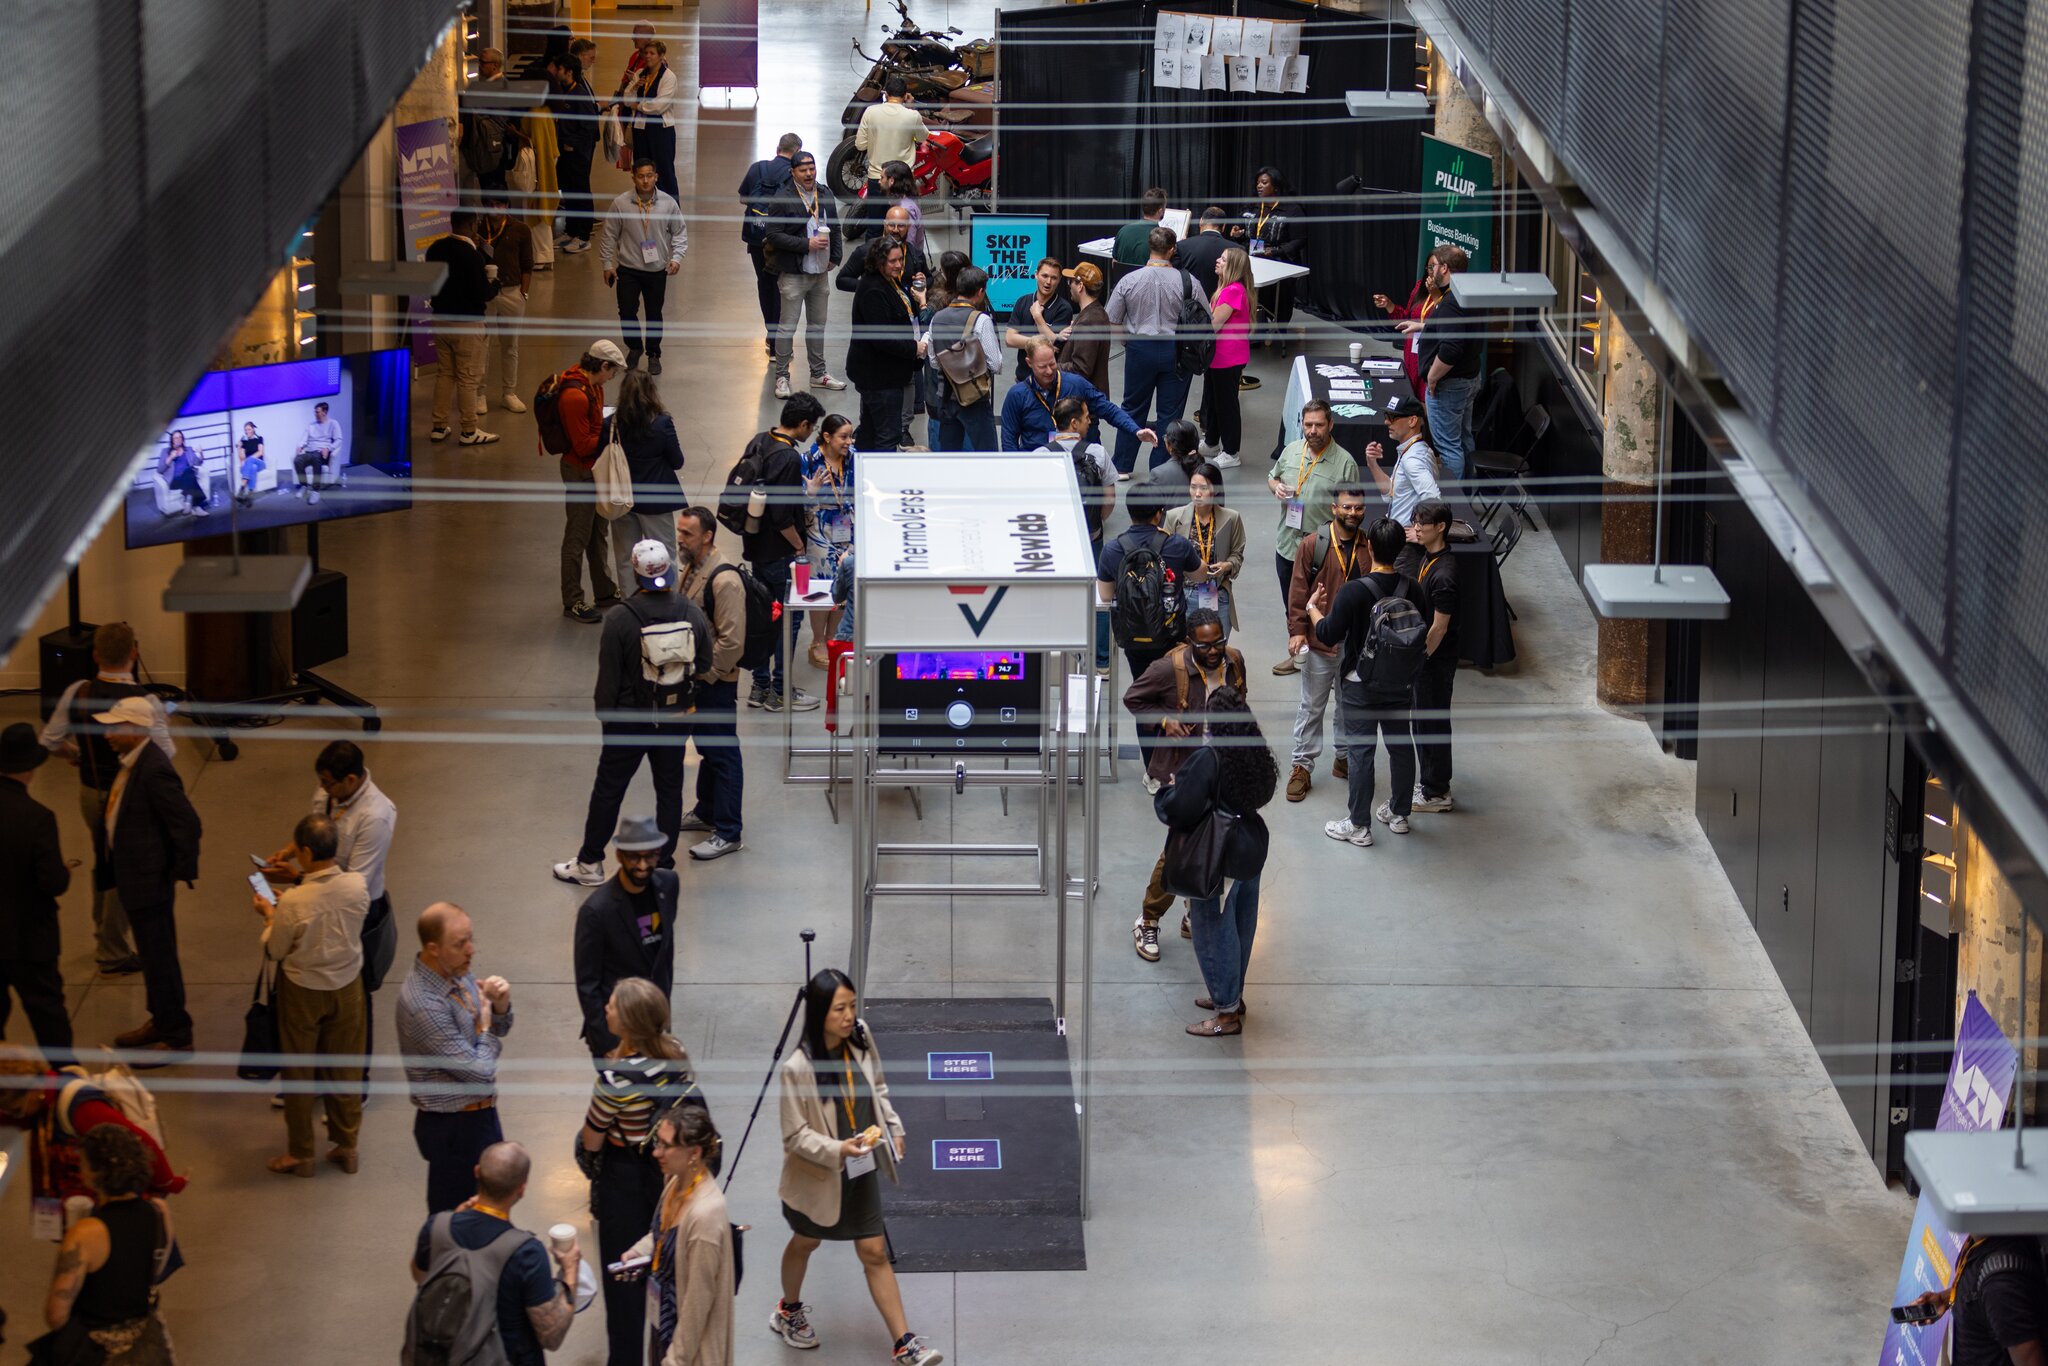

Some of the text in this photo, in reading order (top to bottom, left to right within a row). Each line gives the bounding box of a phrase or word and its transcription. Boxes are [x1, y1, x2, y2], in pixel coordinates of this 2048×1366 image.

[1435, 170, 1476, 197] PILLUR
[986, 234, 1031, 249] SKIP
[1428, 219, 1479, 250] Business Banking
[989, 249, 1027, 264] THE
[987, 265, 1035, 279] LINE.
[892, 488, 929, 571] ThermoVerse
[1007, 513, 1056, 573] Newlab
[998, 665, 1012, 673] 74.7
